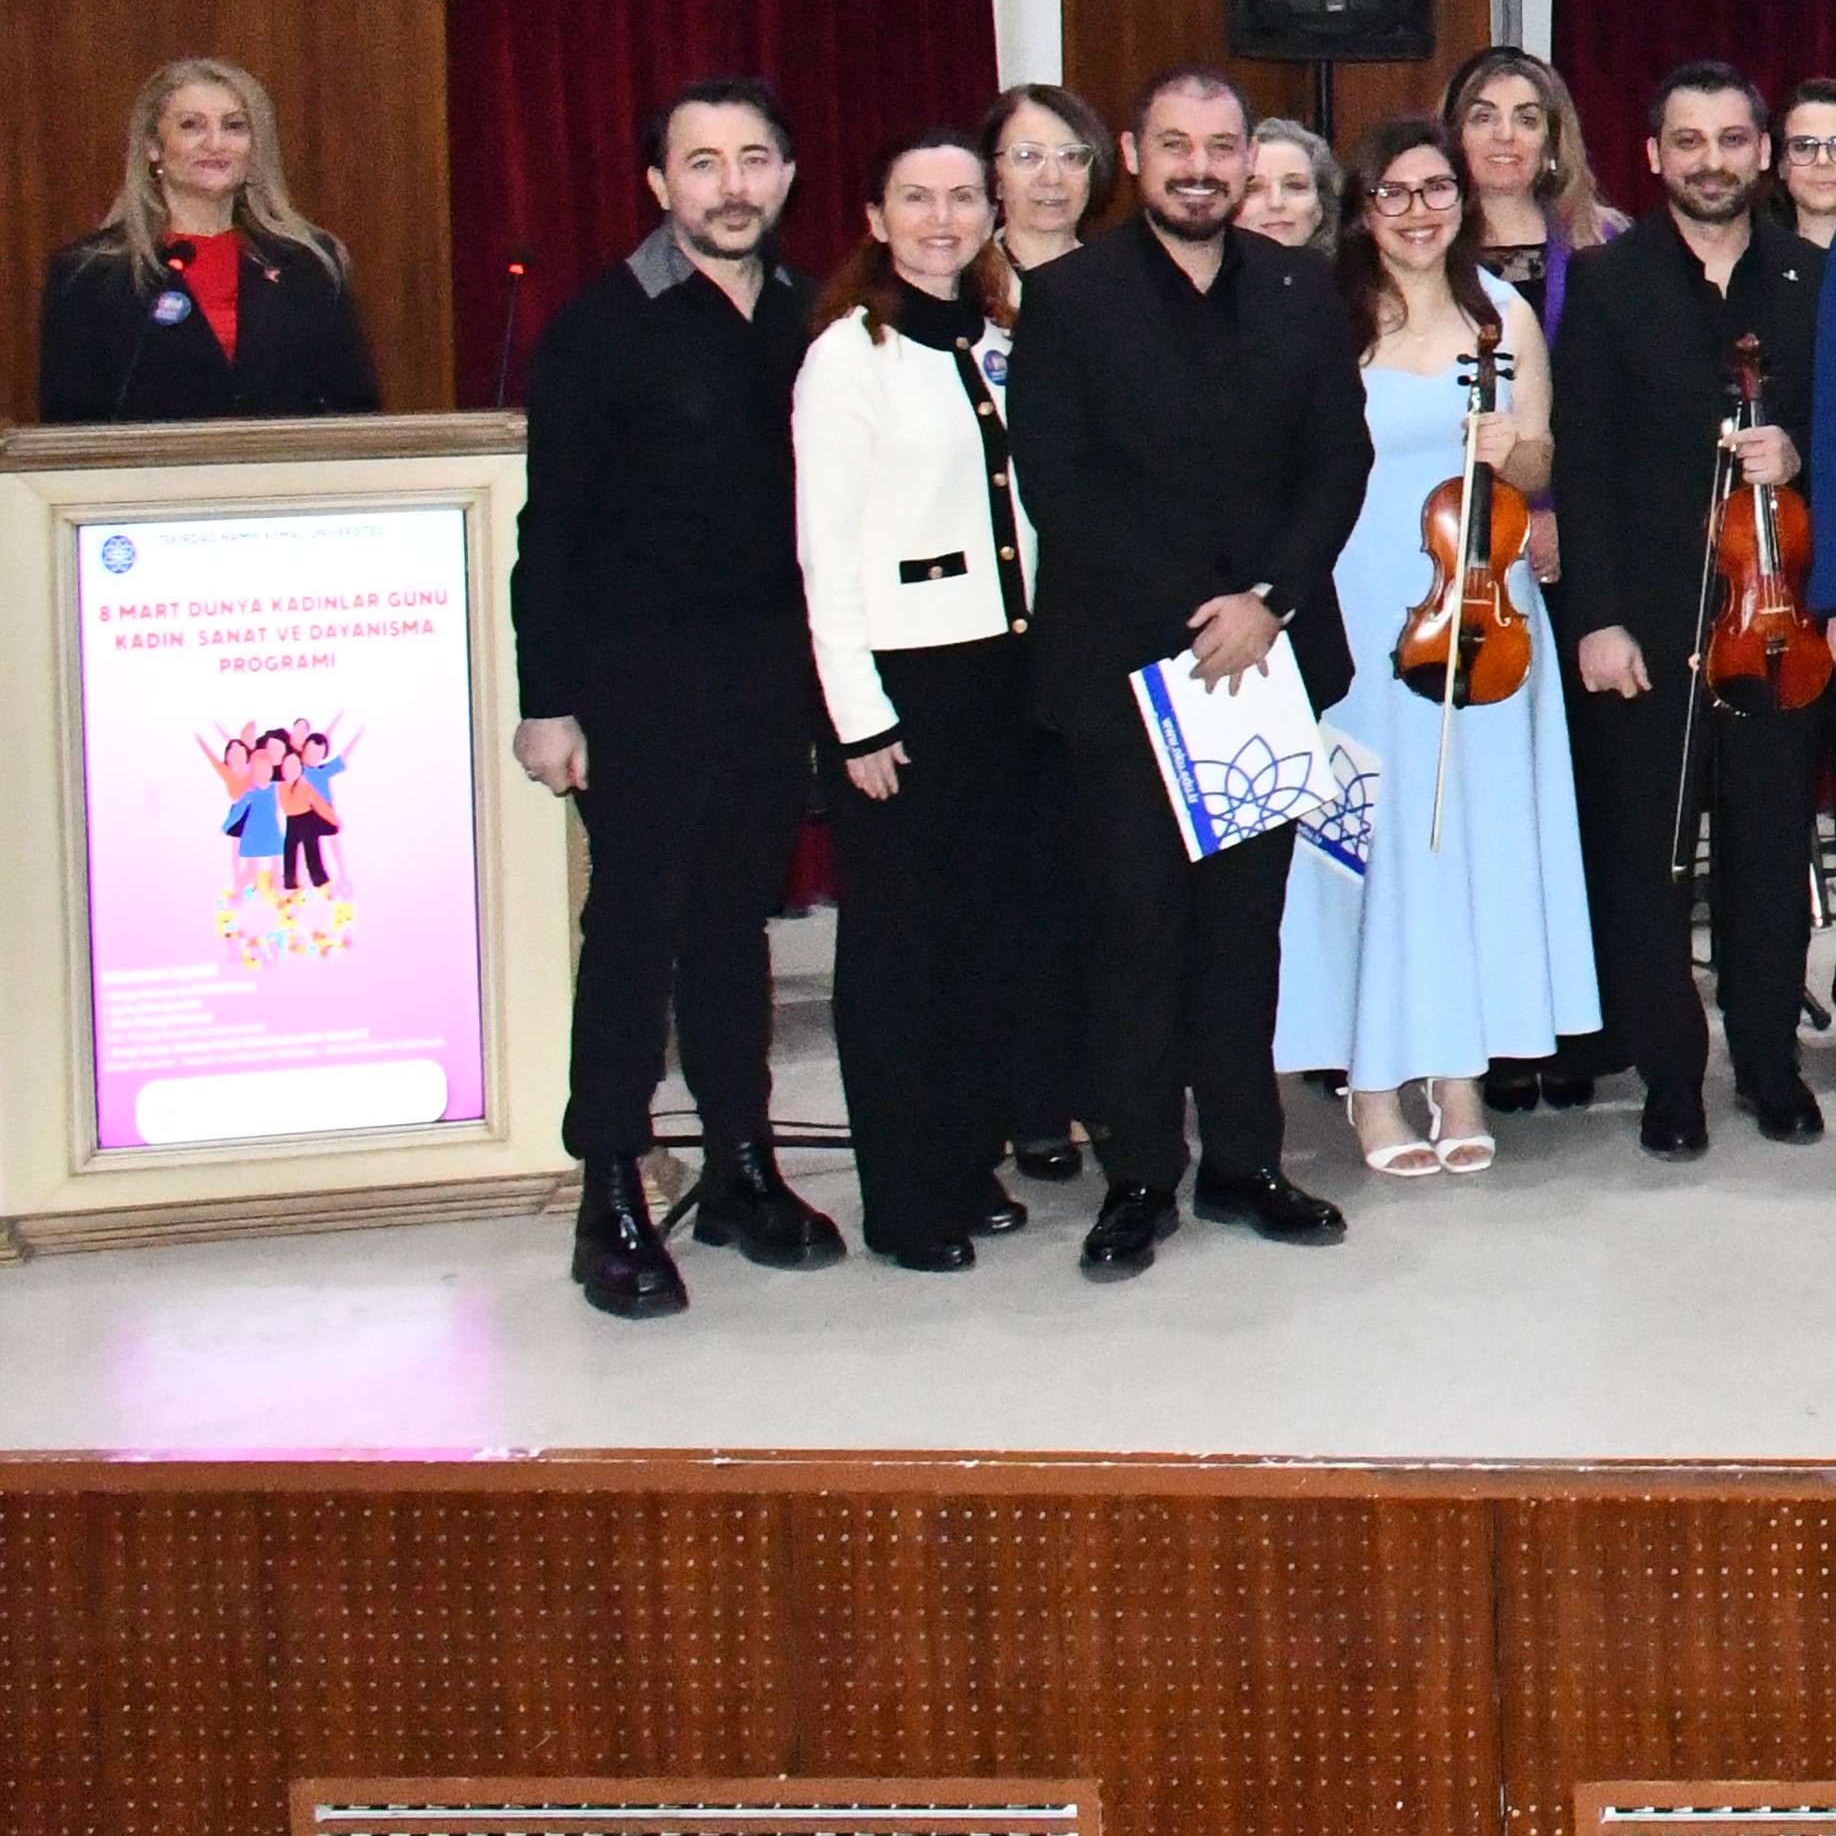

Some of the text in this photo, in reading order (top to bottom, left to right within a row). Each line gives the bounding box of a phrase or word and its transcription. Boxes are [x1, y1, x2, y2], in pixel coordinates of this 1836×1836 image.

[99, 585, 449, 622] 8 MART DÜNYA KADINLAR GÜNÜ
[199, 627, 267, 646] SANAT
[276, 625, 301, 642] VE
[310, 619, 435, 643] DAYANIŞMA
[219, 654, 336, 673] PROGRAMI
[1162, 716, 1199, 804] www.nku.edu.tr
